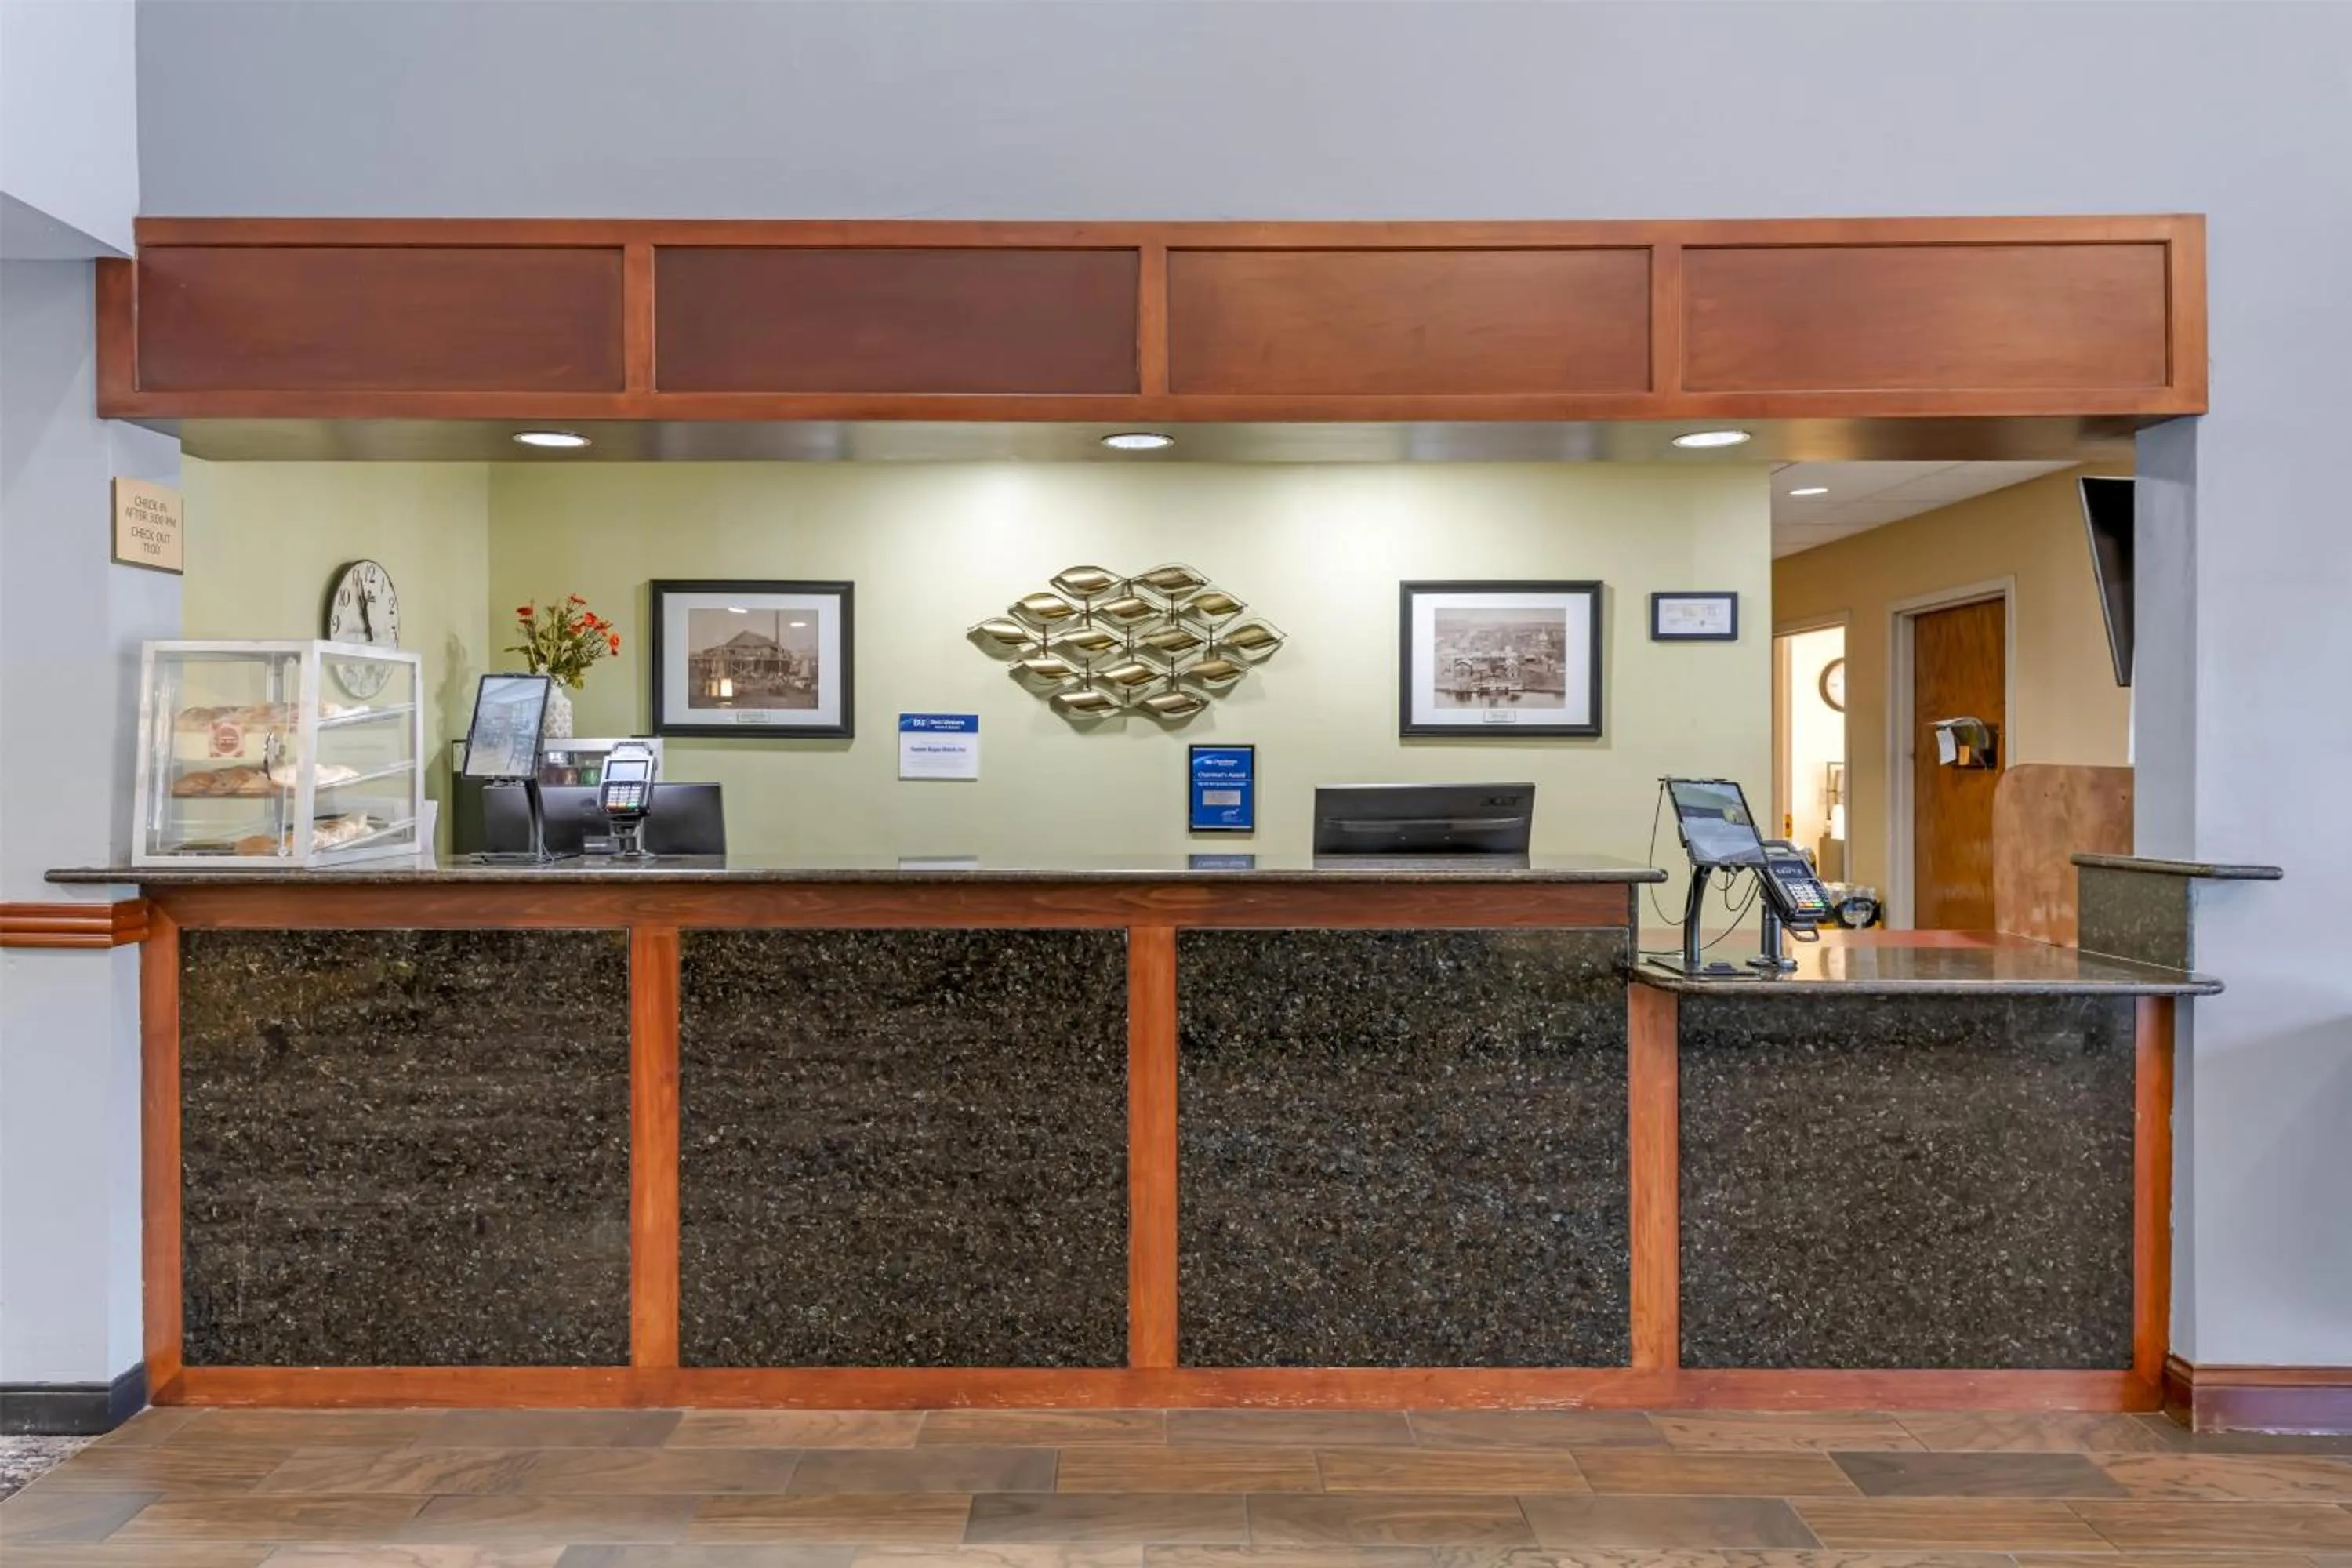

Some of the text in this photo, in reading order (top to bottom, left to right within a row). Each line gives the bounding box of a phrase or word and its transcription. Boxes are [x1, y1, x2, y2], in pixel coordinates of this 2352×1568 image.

[134, 495, 158, 510] CHECK
[125, 507, 147, 521] AFTER
[132, 526, 170, 543] CHECK OUT
[365, 564, 376, 583] 12
[339, 588, 350, 608] 10
[332, 614, 340, 633] 9
